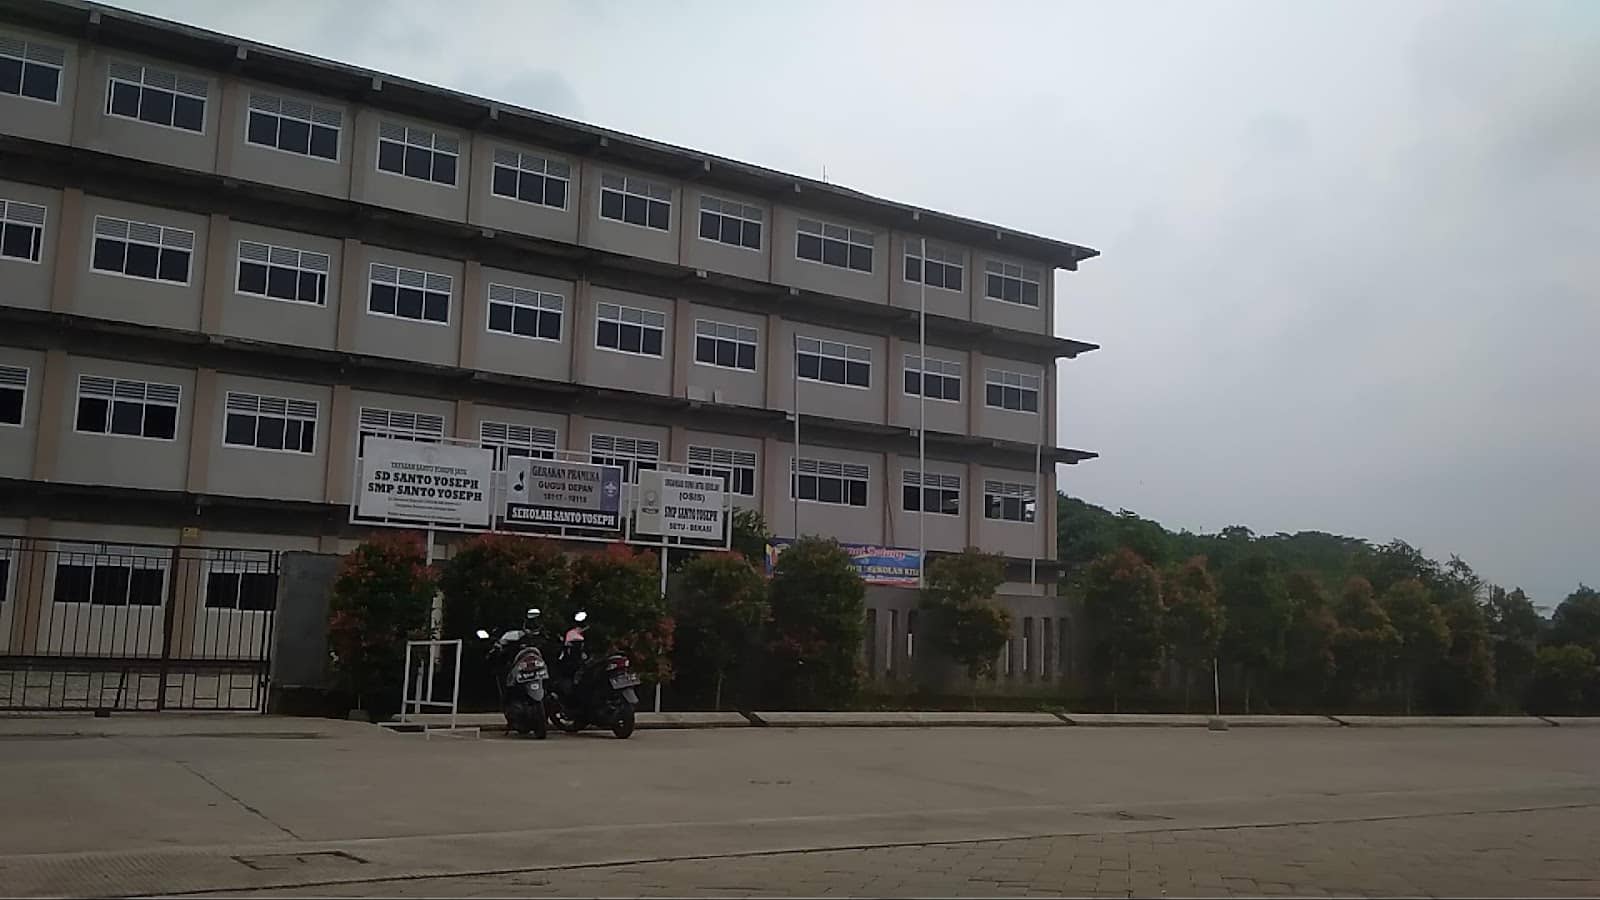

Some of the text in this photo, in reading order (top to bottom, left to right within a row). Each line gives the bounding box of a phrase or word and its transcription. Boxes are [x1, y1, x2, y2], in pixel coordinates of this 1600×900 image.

[375, 470, 479, 489] SD SANTO YOSEPH
[532, 466, 600, 481] GERAKAN PRAMUKA
[368, 482, 394, 493] SMP
[397, 485, 435, 497] SANTO
[438, 489, 482, 501] YOSEPH
[538, 481, 593, 492] GUGUS DEPAN
[679, 492, 705, 503] (OSIS)
[512, 507, 614, 525] SEKOLAH SANTO YOSEPH
[690, 524, 712, 532] BEKASI
